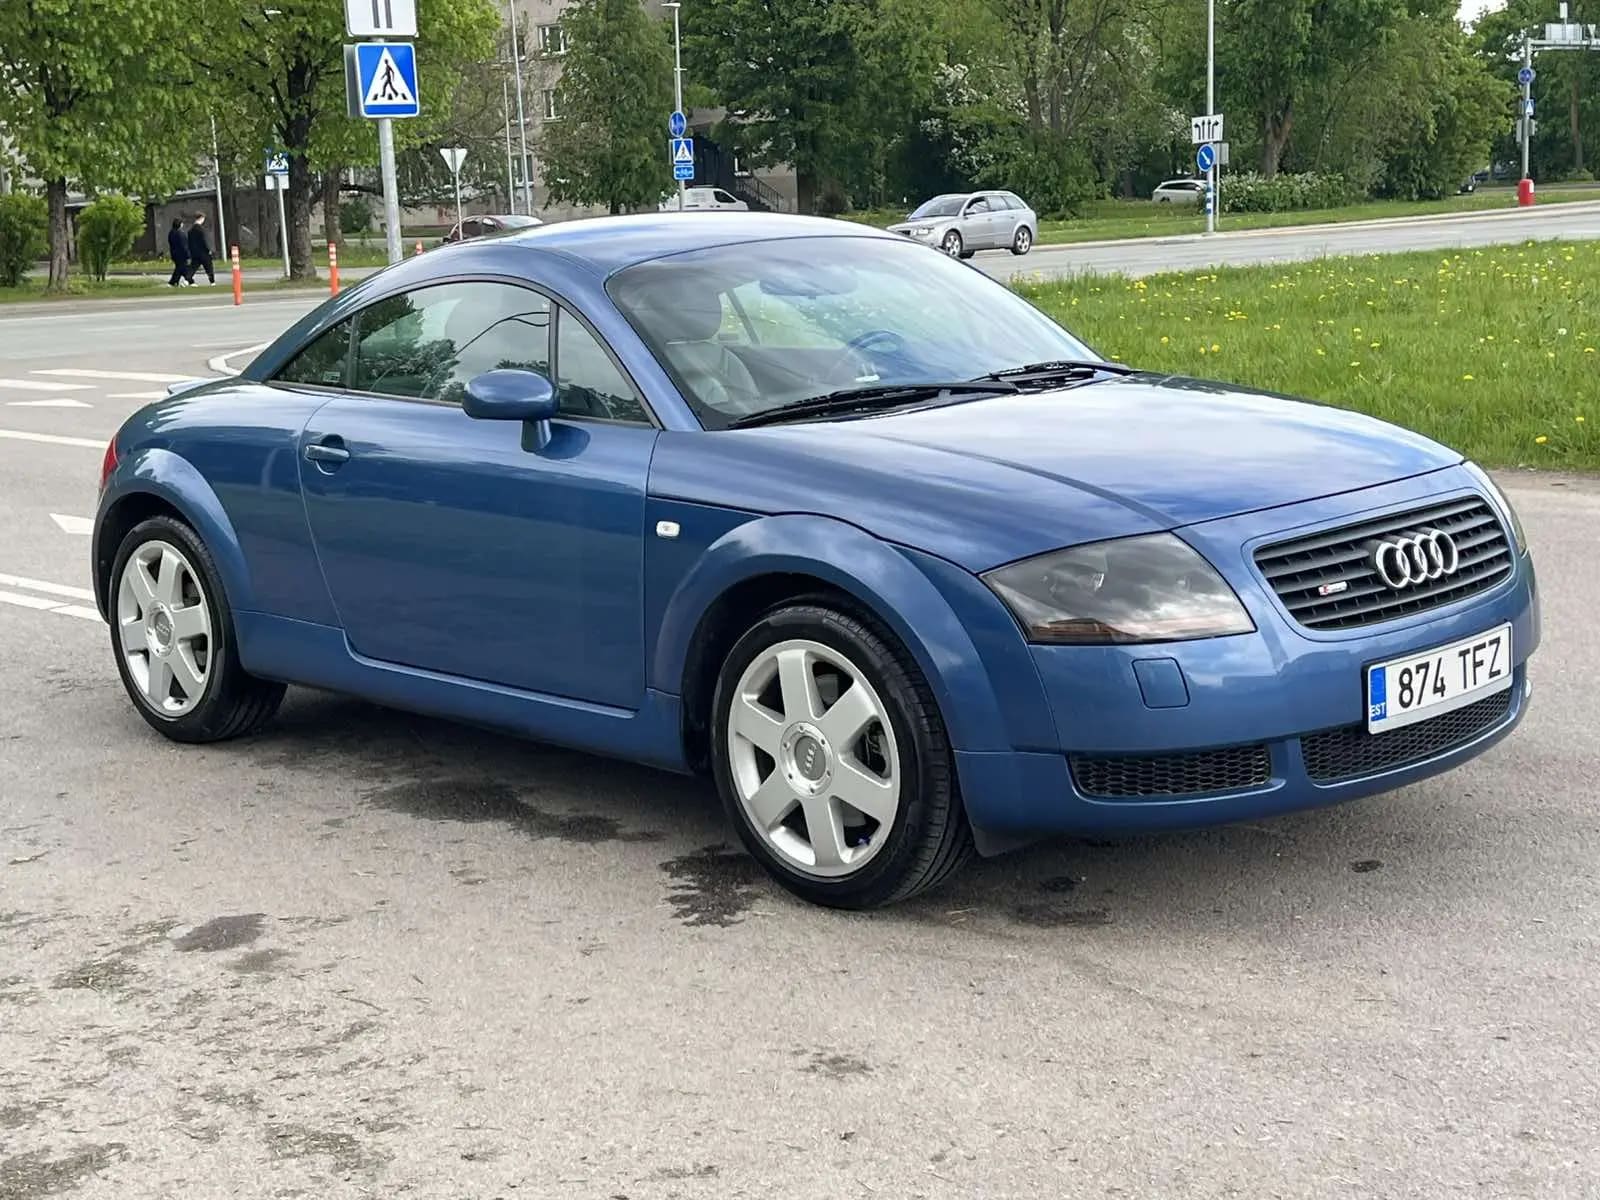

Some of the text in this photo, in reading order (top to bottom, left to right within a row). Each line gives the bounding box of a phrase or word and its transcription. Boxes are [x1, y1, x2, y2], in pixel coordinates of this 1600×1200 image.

[1398, 636, 1501, 709] 874 TFZ
[1370, 702, 1386, 717] EST
